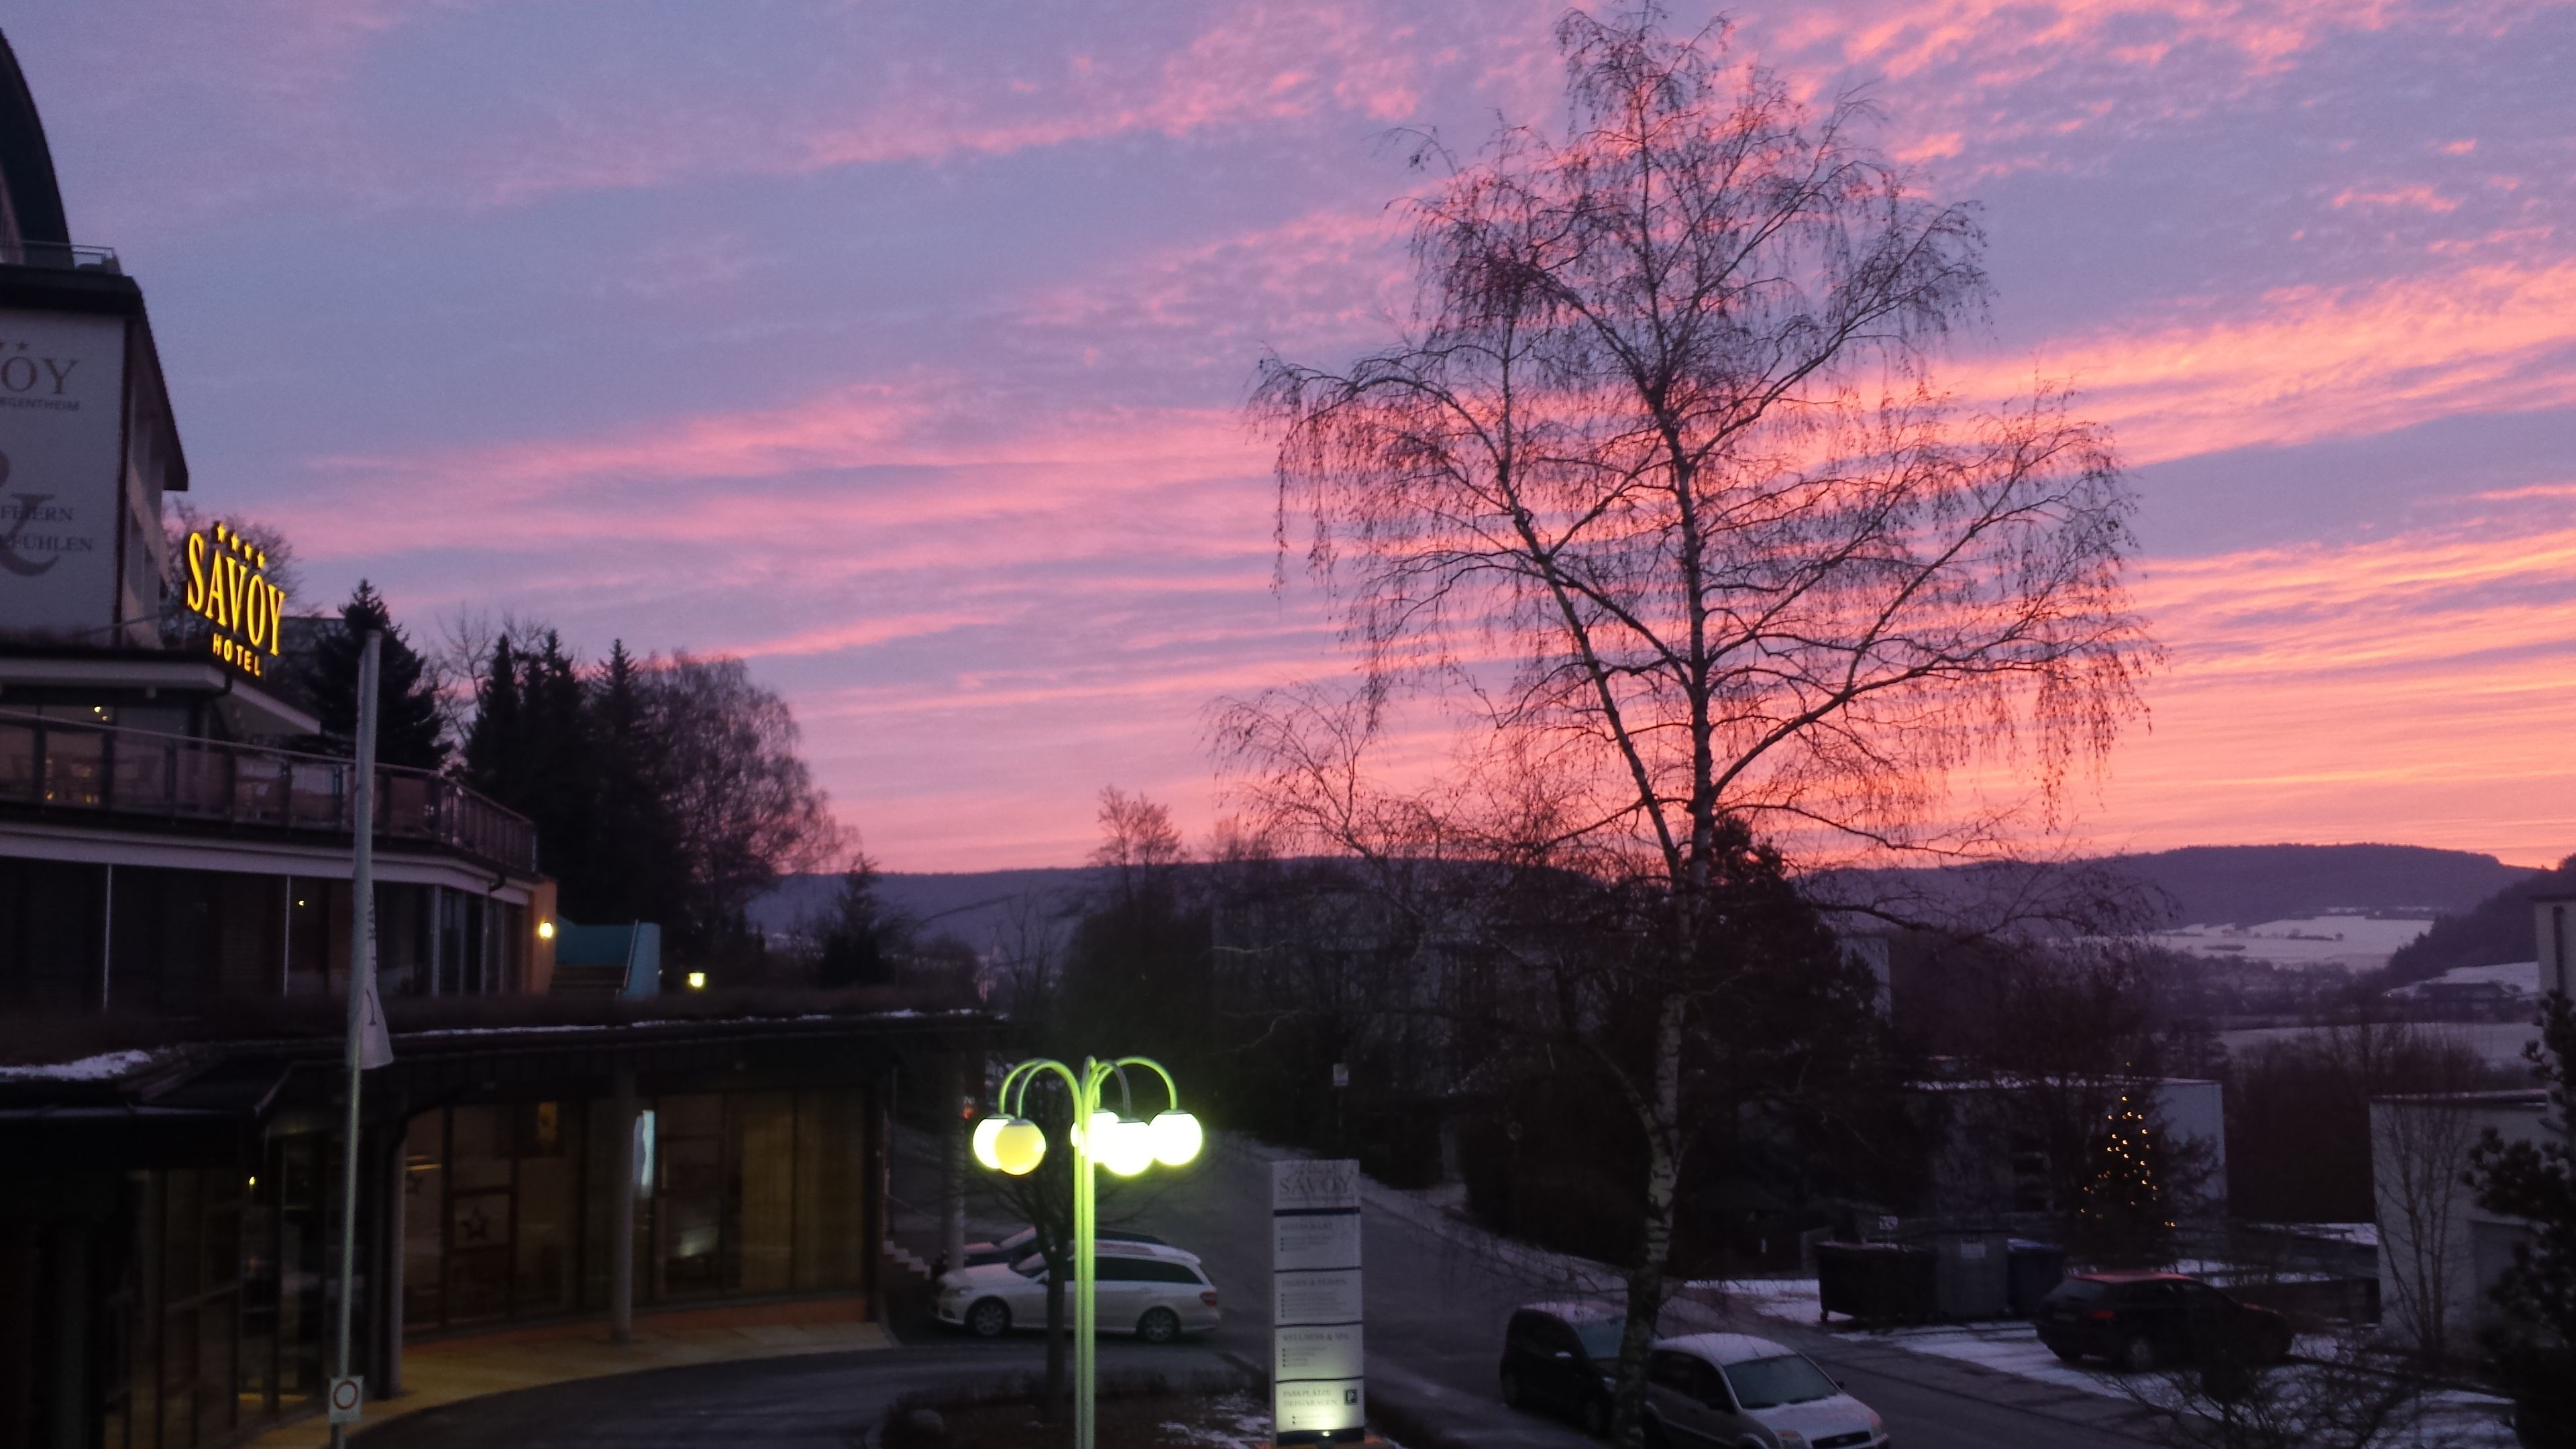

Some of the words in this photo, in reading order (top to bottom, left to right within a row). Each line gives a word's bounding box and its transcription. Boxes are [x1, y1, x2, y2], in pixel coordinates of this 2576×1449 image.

[187, 532, 286, 656] SAVOY
[212, 633, 262, 678] HOTEL
[1279, 1169, 1353, 1195] SAVOY
[1283, 1333, 1324, 1342] WELLNESS
